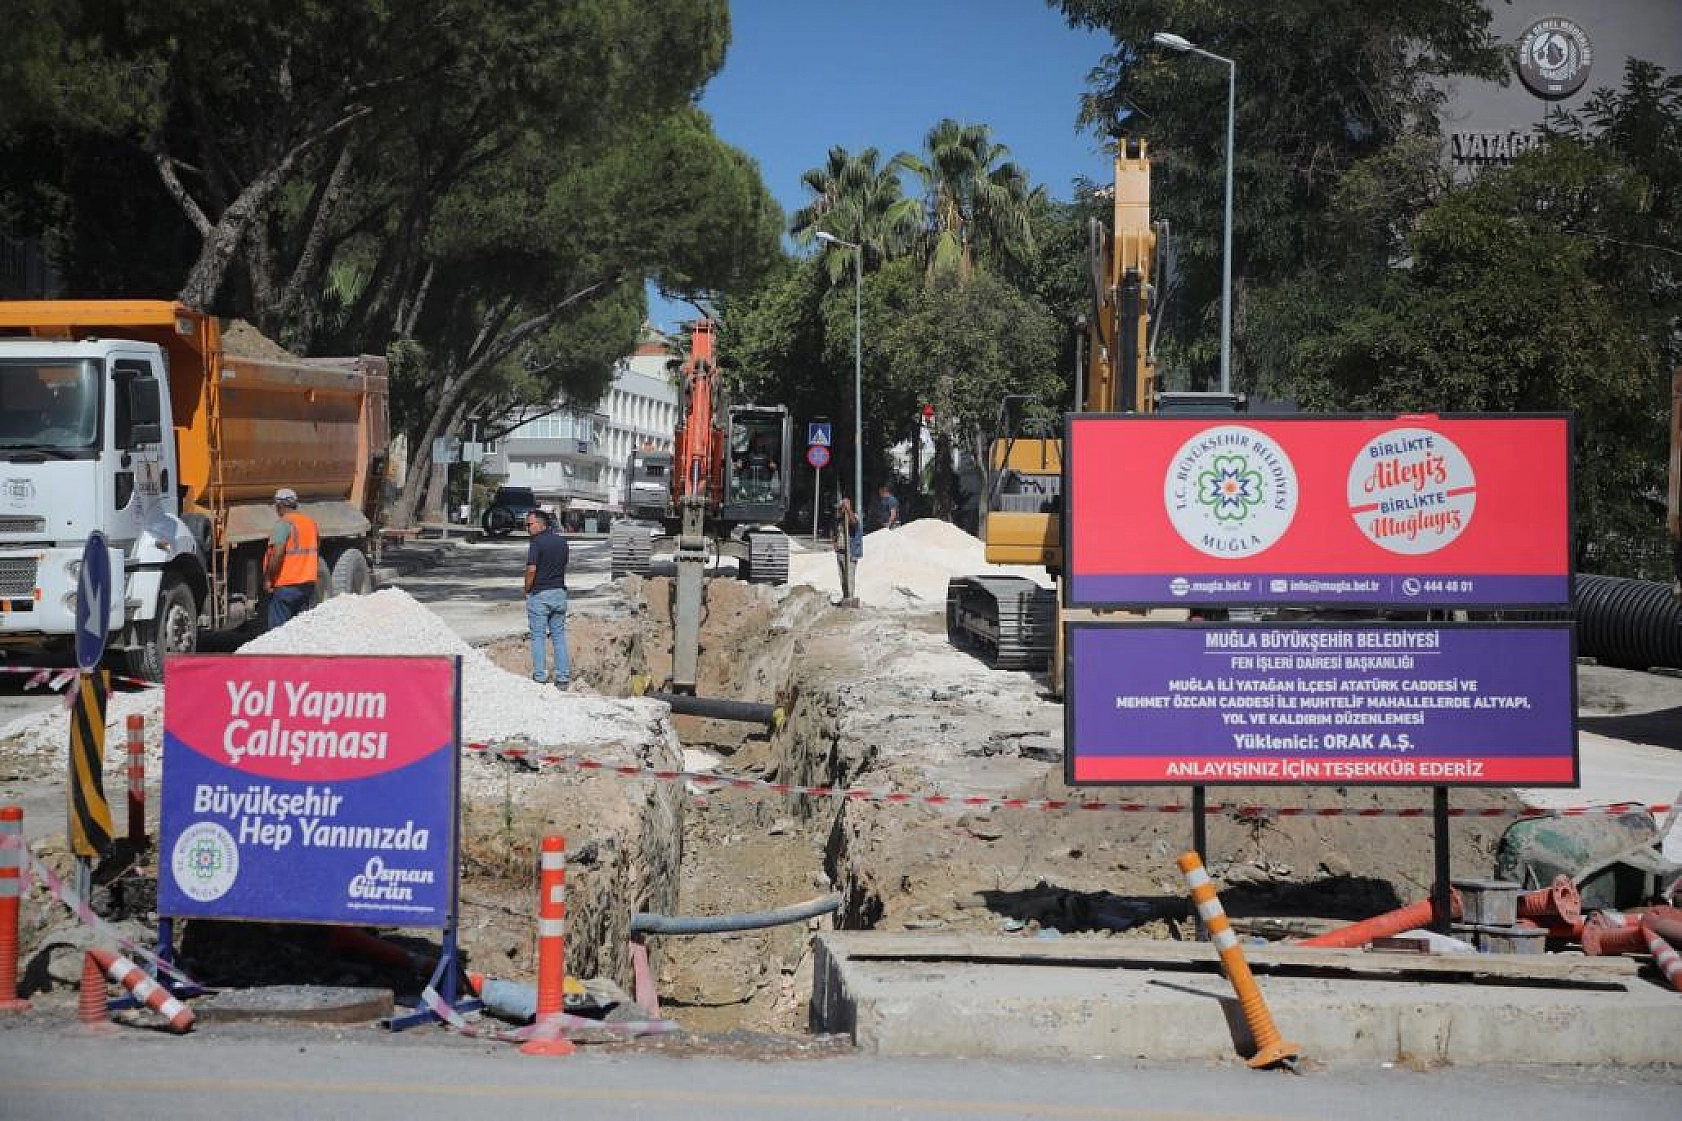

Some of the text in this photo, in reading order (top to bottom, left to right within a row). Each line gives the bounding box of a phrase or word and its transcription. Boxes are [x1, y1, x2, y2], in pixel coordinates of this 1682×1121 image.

[1369, 436, 1435, 458] BİRLİKTE
[1177, 433, 1250, 480] BÜYÜKŞEHİR
[1253, 442, 1288, 511] BELEDİYESİ
[1364, 451, 1448, 493] Aileyiz
[1380, 491, 1446, 514] BİRLİKTE
[1369, 509, 1461, 541] Muğlayız
[1203, 534, 1261, 551] MUĞLA
[1290, 579, 1379, 593] info@mugla.bel.tr
[1423, 580, 1443, 591] 444
[1460, 580, 1474, 591] 01
[1205, 630, 1439, 652] MUĞLA BÜYÜKŞEHİR BELEDİYESİ
[1231, 654, 1414, 672] FEN İŞLERİ DAİRESİ BAŞKANLIĞI
[1169, 677, 1479, 693] MUĞLA İLİ YATAĞAN İLÇESİ ATATÜRK CADDESİ VE
[226, 680, 387, 725] Yol Yapım
[1116, 694, 1531, 709] MEHMET ÖZCAN CADDESİ İLE MUHTELİF MAHALLELERDE ALTYAPI,
[1222, 711, 1424, 725] YOL VE KALDIRIM DÜZENLEMESİ
[223, 719, 389, 766] Çalışması
[1233, 733, 1414, 752] Yüklenici: ORAK A.Ş.
[1166, 759, 1484, 778] ANLAYIŞINIZ İÇİN TEŞEKKÜR EDERİZ
[193, 784, 342, 821] Büyükşehir
[239, 816, 429, 851] Hep Yanınızda
[365, 856, 434, 883] Osman
[348, 875, 412, 901] Gürün
